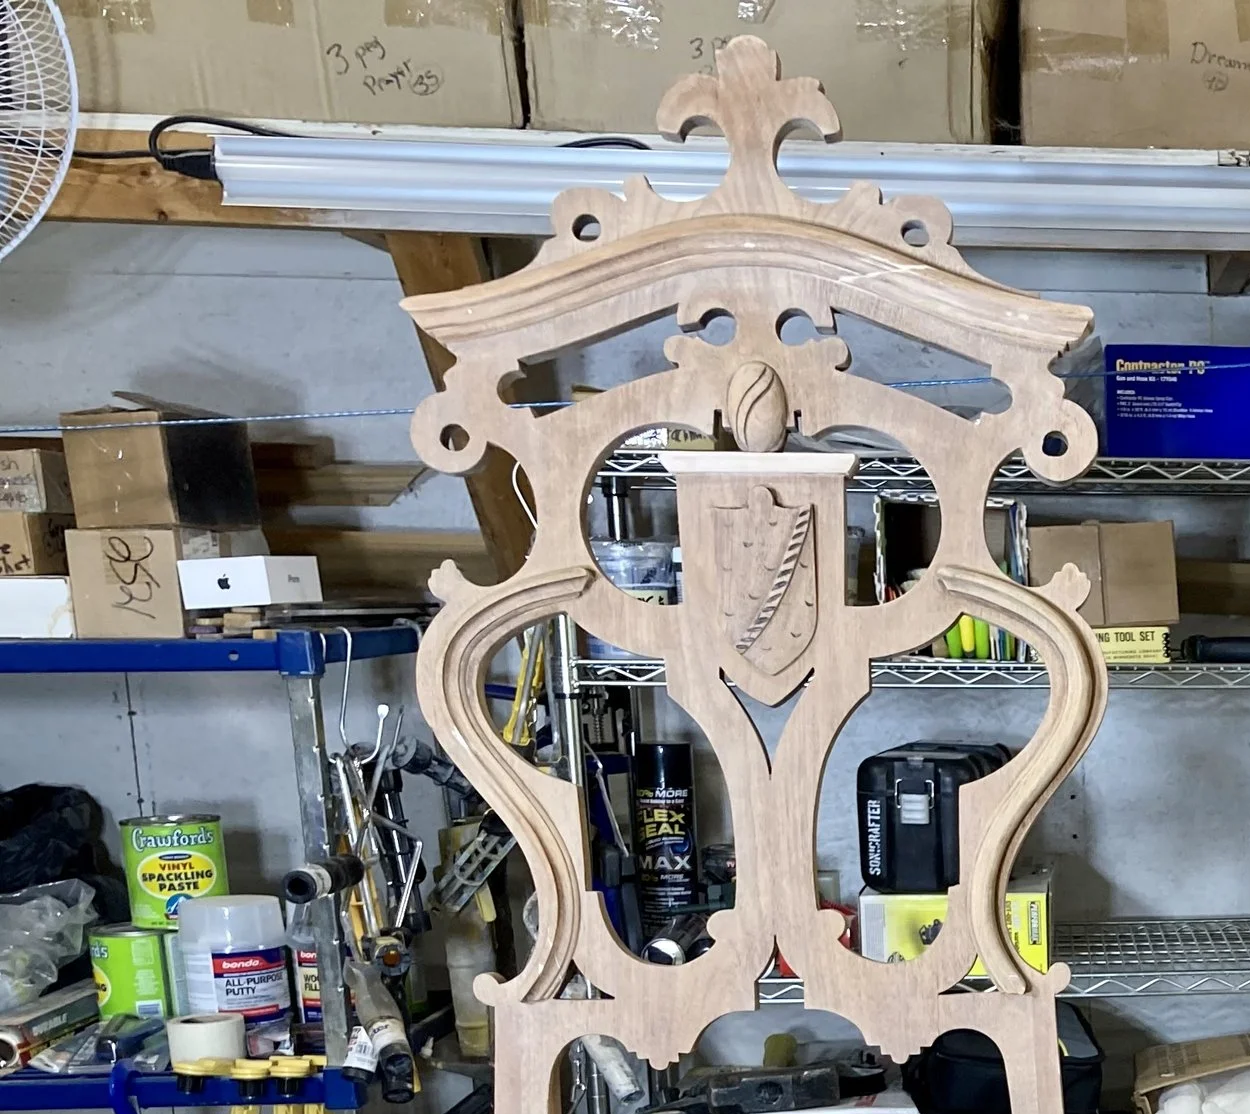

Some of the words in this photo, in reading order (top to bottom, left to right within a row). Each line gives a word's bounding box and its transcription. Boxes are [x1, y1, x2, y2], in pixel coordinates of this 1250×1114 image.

[690, 37, 703, 60] 3
[326, 43, 350, 75] 3
[1114, 631, 1136, 642] TOOL
[1140, 630, 1156, 642] SET
[655, 788, 688, 798] MORE
[158, 862, 195, 871] VINYL
[141, 869, 214, 882] SPACKLING
[158, 881, 200, 892] PASTE
[222, 959, 260, 969] bondo
[226, 986, 257, 996] PUTTY
